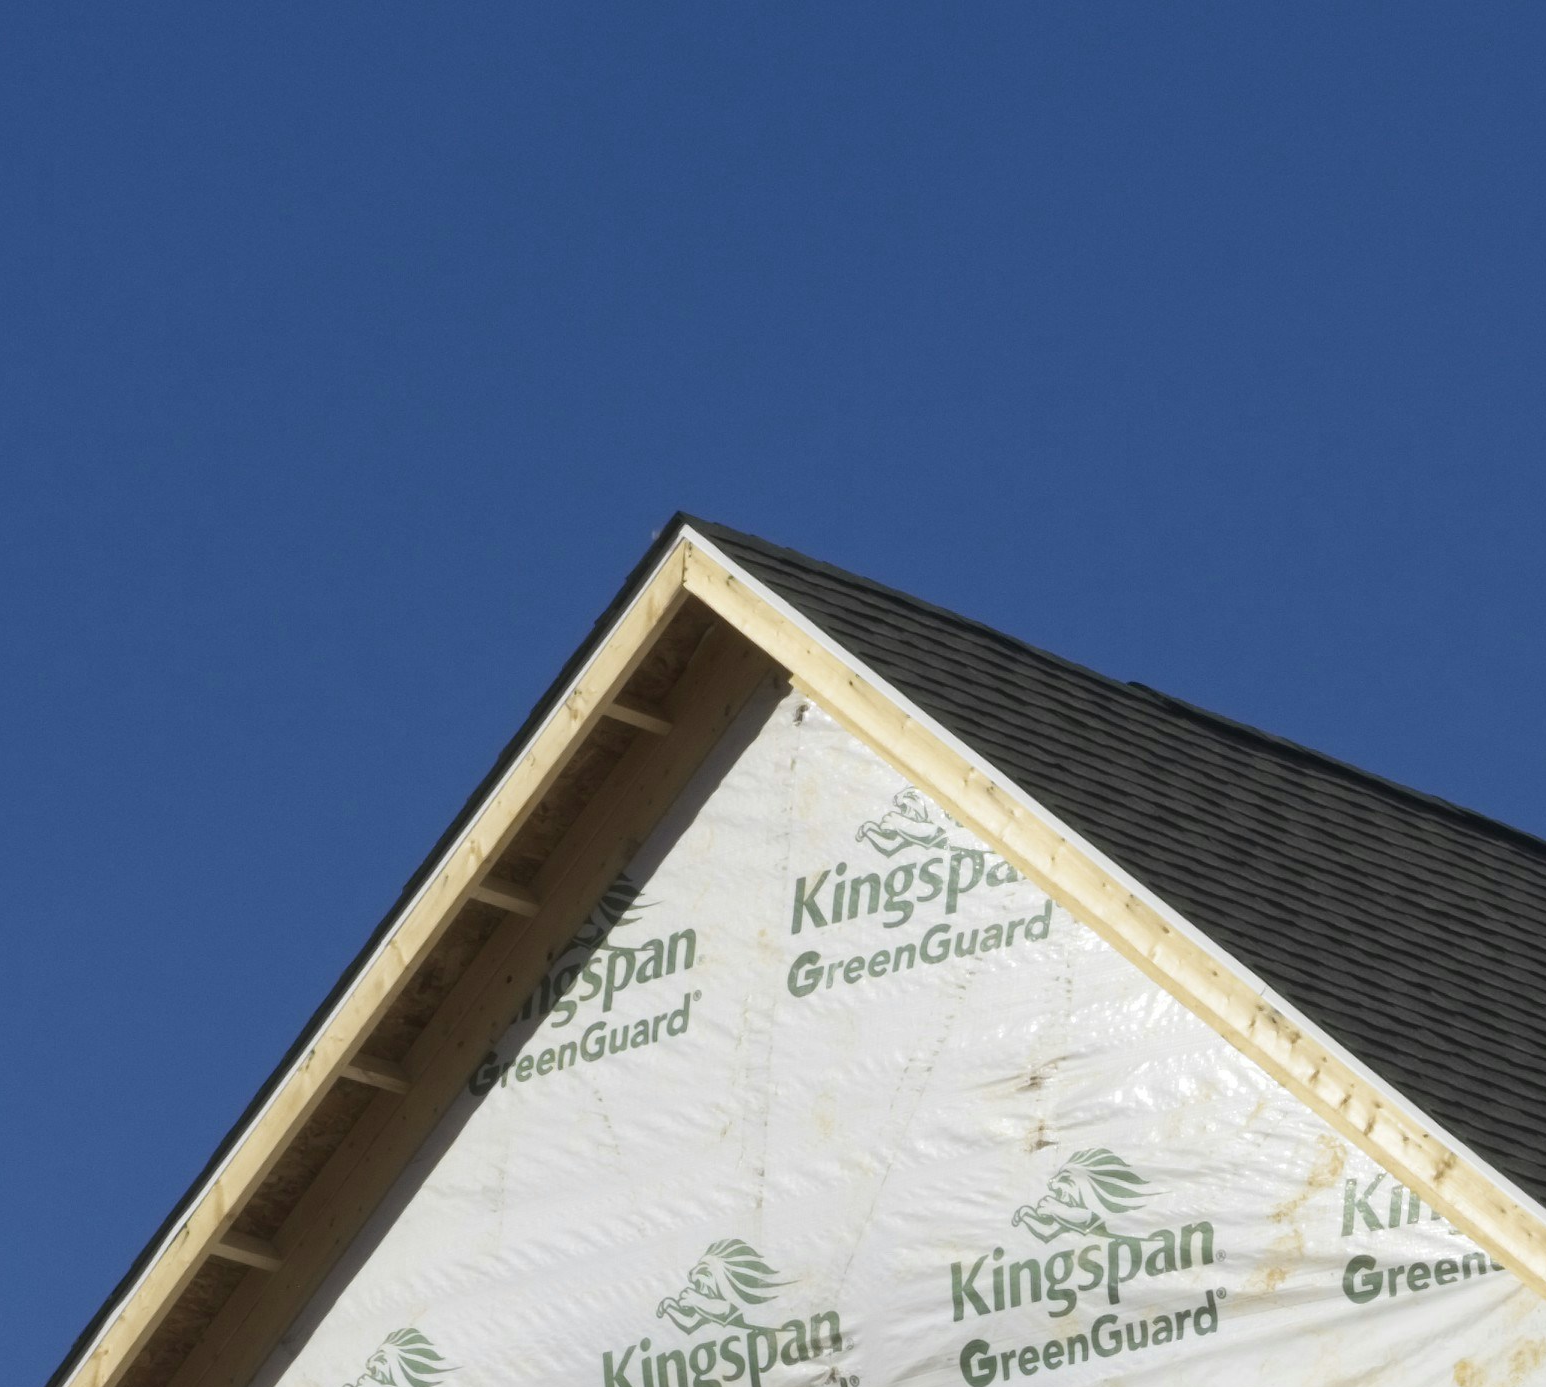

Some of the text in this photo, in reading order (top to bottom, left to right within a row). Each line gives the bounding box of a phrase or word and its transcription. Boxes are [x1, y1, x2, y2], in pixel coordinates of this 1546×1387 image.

[790, 847, 1018, 935] Kingspa
[787, 899, 1053, 998] GreenGuard
[468, 992, 694, 1098] GreenGuard
[951, 1220, 1216, 1322] Kingspan
